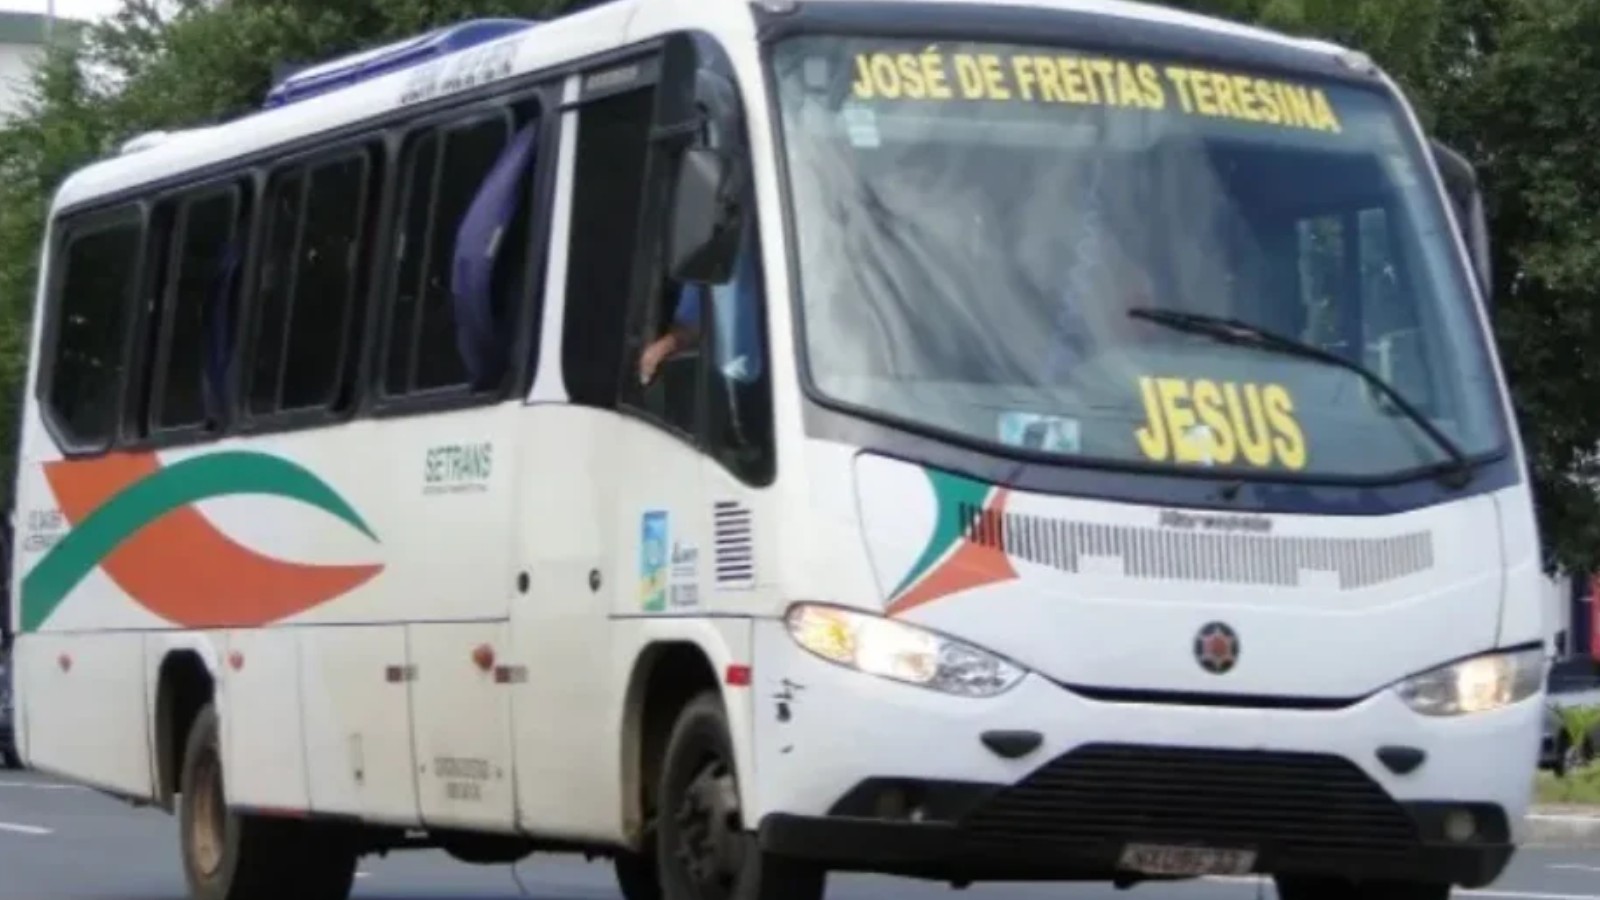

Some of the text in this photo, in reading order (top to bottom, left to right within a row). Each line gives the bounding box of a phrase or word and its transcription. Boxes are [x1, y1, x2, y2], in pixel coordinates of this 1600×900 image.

[853, 46, 1340, 132] JOSÉ DE FREITAS TERESINA
[1135, 376, 1306, 469] JESUS
